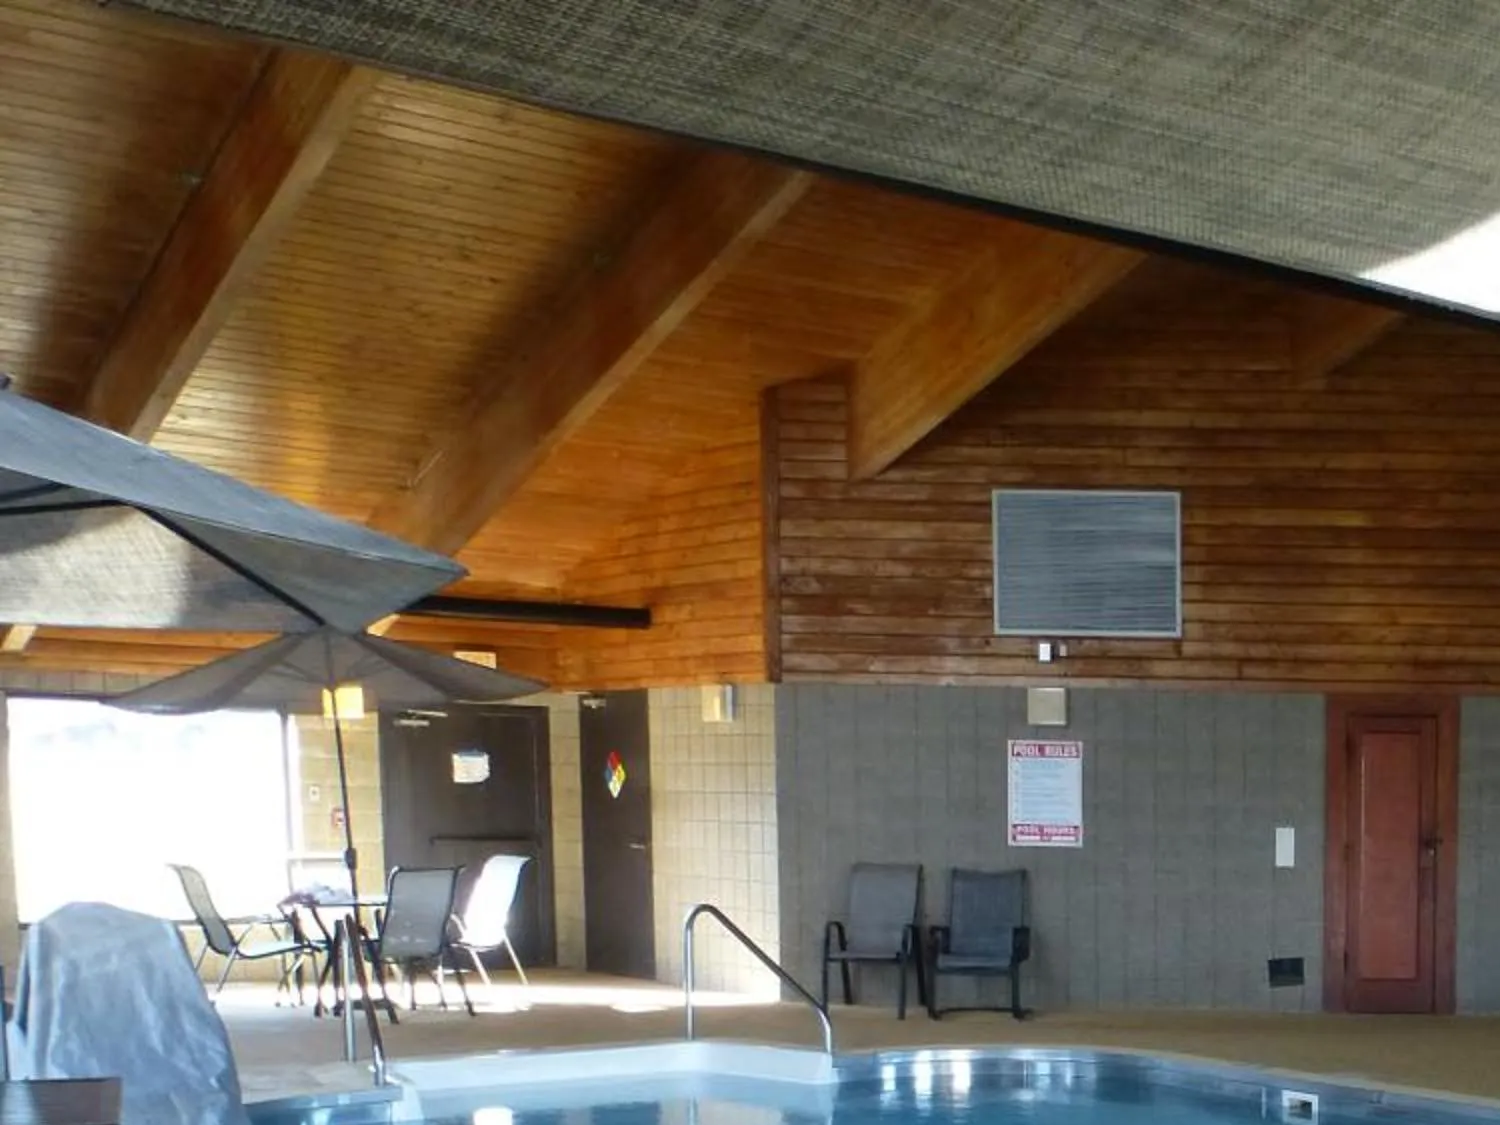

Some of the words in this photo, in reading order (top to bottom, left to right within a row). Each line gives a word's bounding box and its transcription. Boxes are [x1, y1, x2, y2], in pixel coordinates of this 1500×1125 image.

[1013, 745, 1040, 757] POOL
[1044, 745, 1078, 757] RULES
[1016, 826, 1041, 834] POOL
